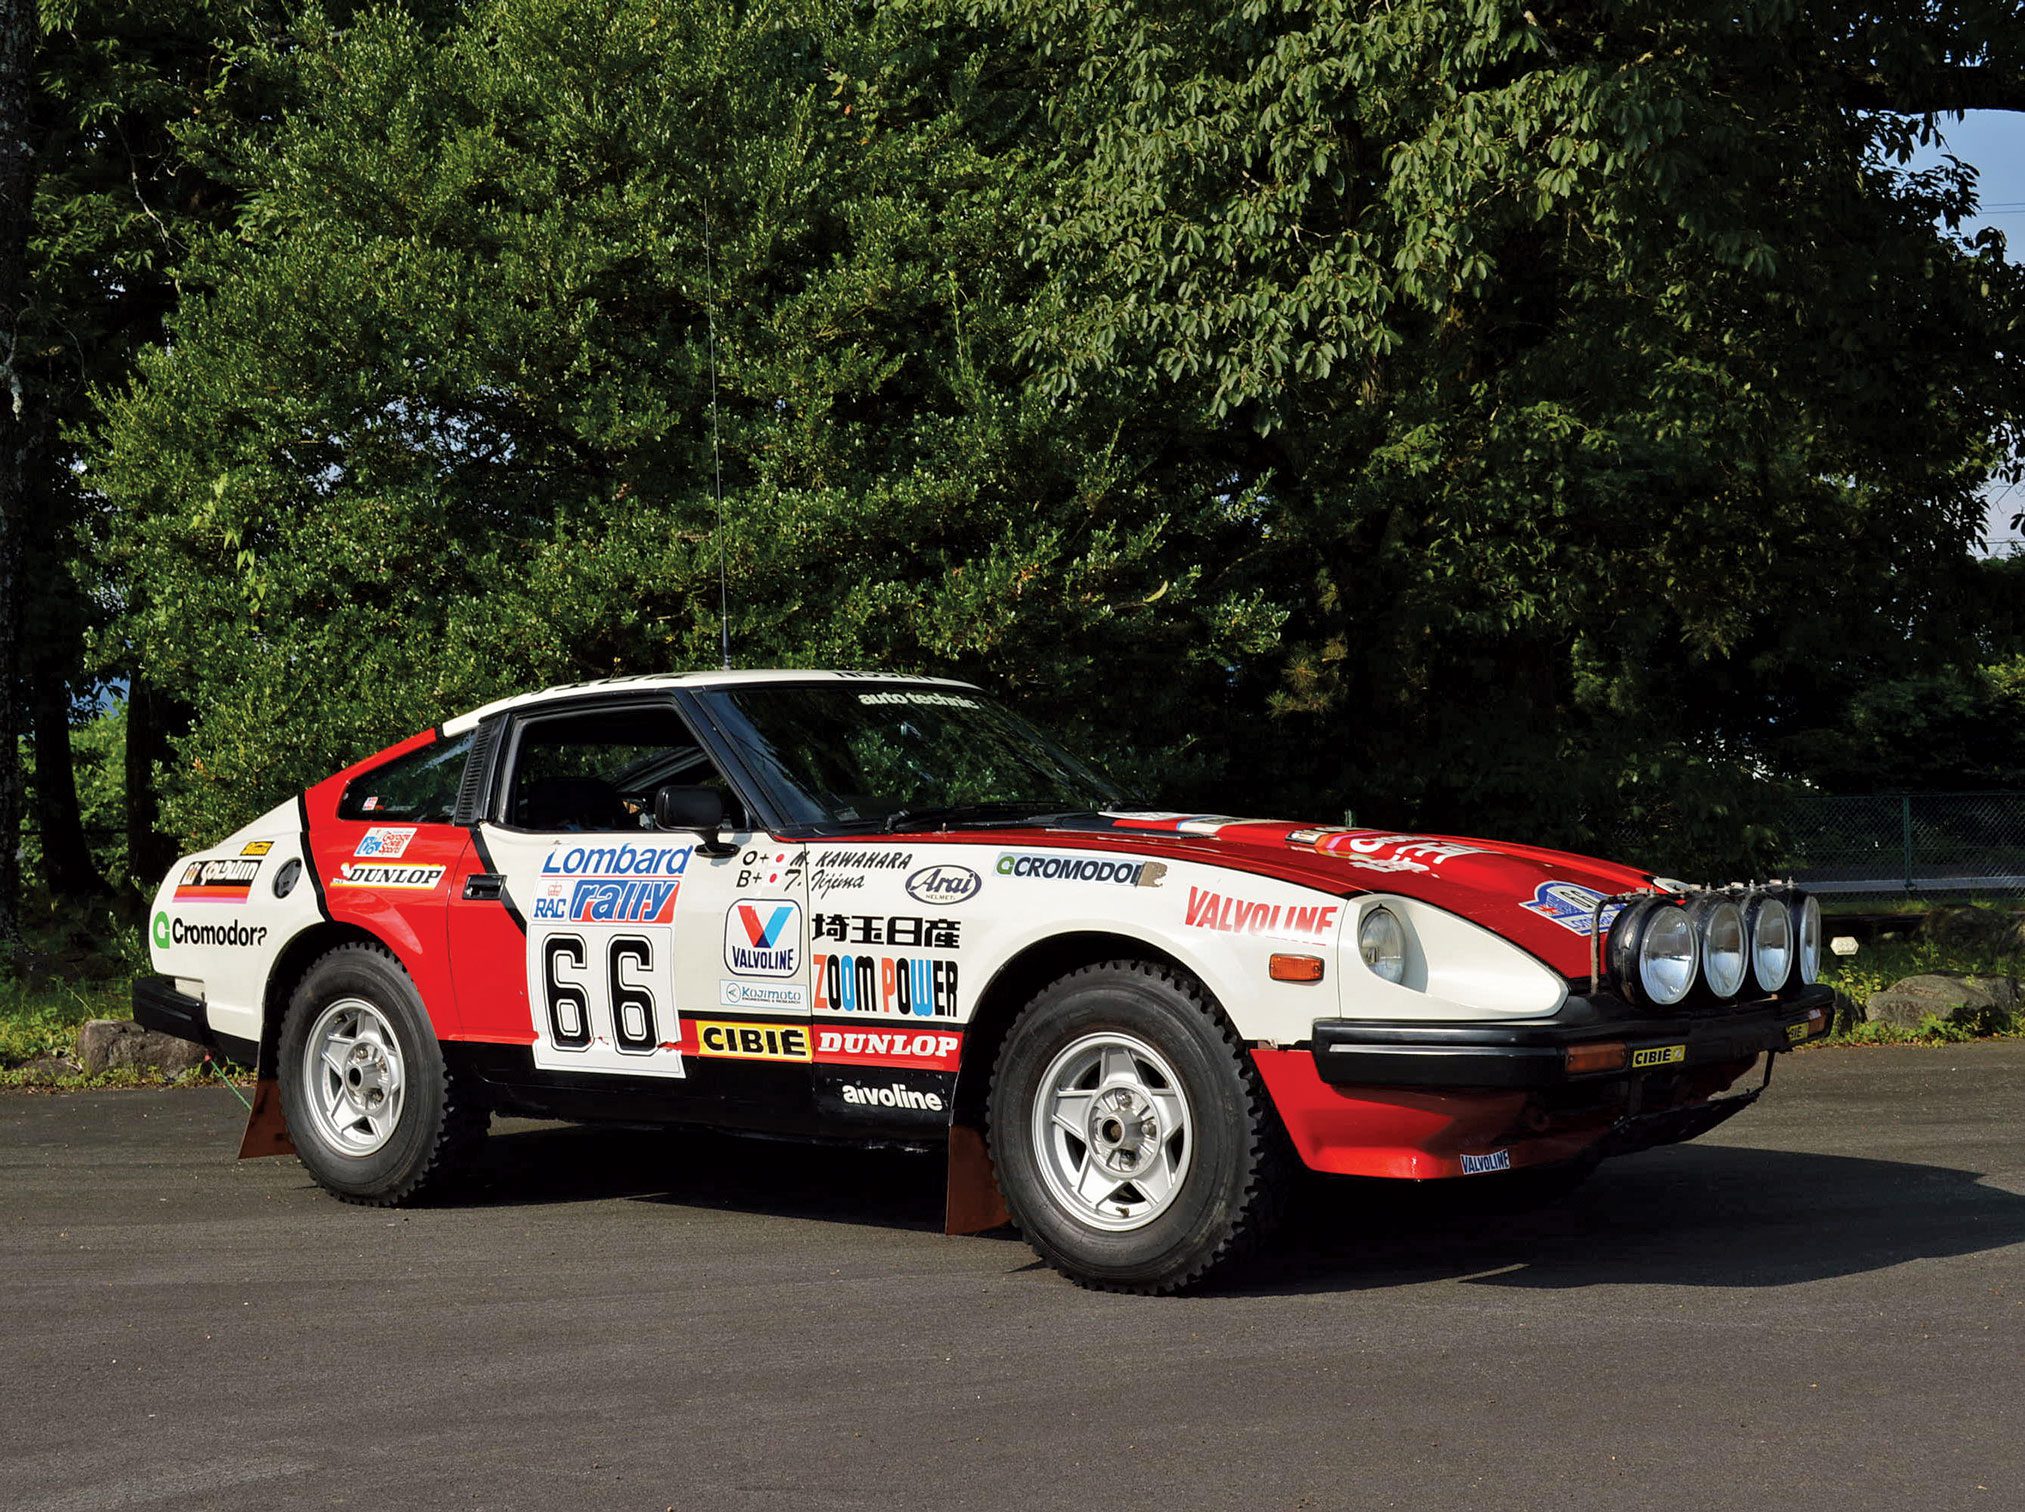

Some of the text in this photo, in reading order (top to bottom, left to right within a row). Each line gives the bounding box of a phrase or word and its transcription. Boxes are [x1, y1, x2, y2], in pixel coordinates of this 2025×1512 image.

[858, 692, 979, 709] auto technic
[542, 842, 694, 875] Lombard
[815, 851, 913, 870] KAWAHARA
[348, 868, 442, 884] DUNLOP
[911, 868, 976, 893] Arai
[534, 898, 566, 918] RAC
[572, 881, 676, 920] rally
[812, 913, 961, 949] 埼玉日産
[732, 945, 794, 971] VALVOLINE
[541, 932, 660, 1056] 66
[813, 954, 959, 1018] ZOOM POWER
[818, 1031, 959, 1057] DUNLOP
[1461, 1151, 1509, 1173] VALVOLINE
